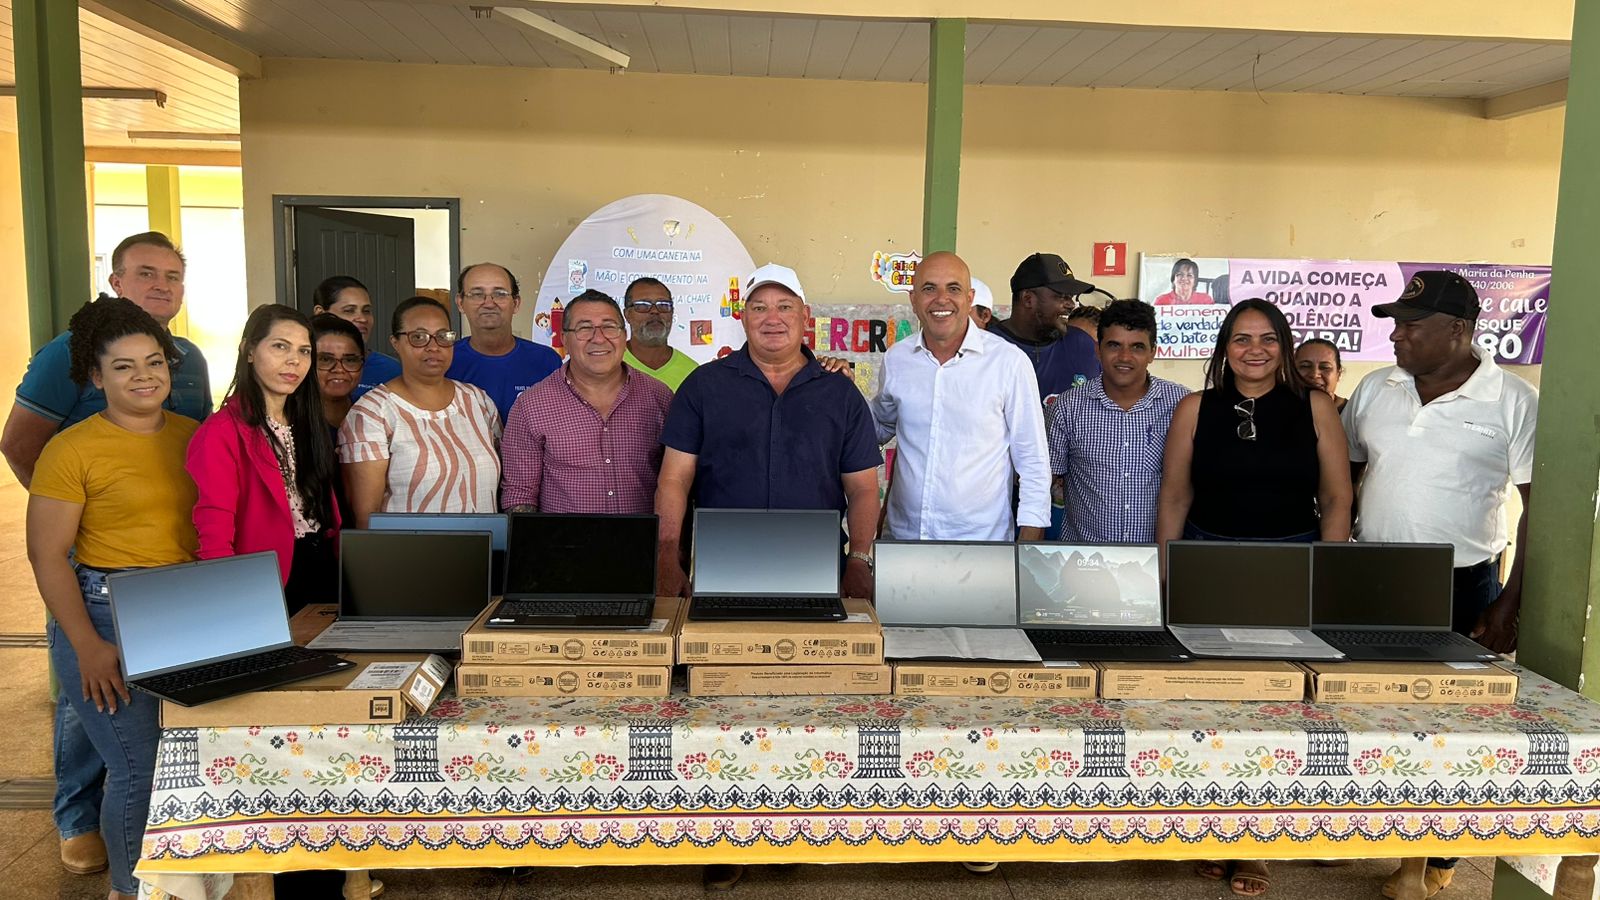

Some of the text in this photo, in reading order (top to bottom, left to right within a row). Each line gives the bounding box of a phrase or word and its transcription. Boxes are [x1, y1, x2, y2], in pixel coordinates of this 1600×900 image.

[613, 248, 701, 261] COM UMA CANETA NA
[595, 271, 617, 281] MÃO
[620, 274, 626, 283] E
[892, 271, 914, 285] Cria
[1458, 269, 1488, 278] Maria
[1490, 270, 1502, 278] da
[1505, 269, 1535, 279] Penha
[1241, 271, 1254, 284] A
[1258, 271, 1303, 285] VIDA
[1307, 272, 1388, 290] COMEÇA
[1469, 281, 1515, 290] 340/2006
[687, 294, 711, 304] CHAVE
[1265, 291, 1361, 308] QUANDO A
[1161, 306, 1228, 317] Homem
[1285, 308, 1362, 327] OLÊNCIA
[1475, 319, 1523, 331] ISQUE
[852, 316, 920, 353] CRIA
[1157, 332, 1178, 344] não
[1181, 332, 1208, 344] bate
[1477, 333, 1523, 359] 80
